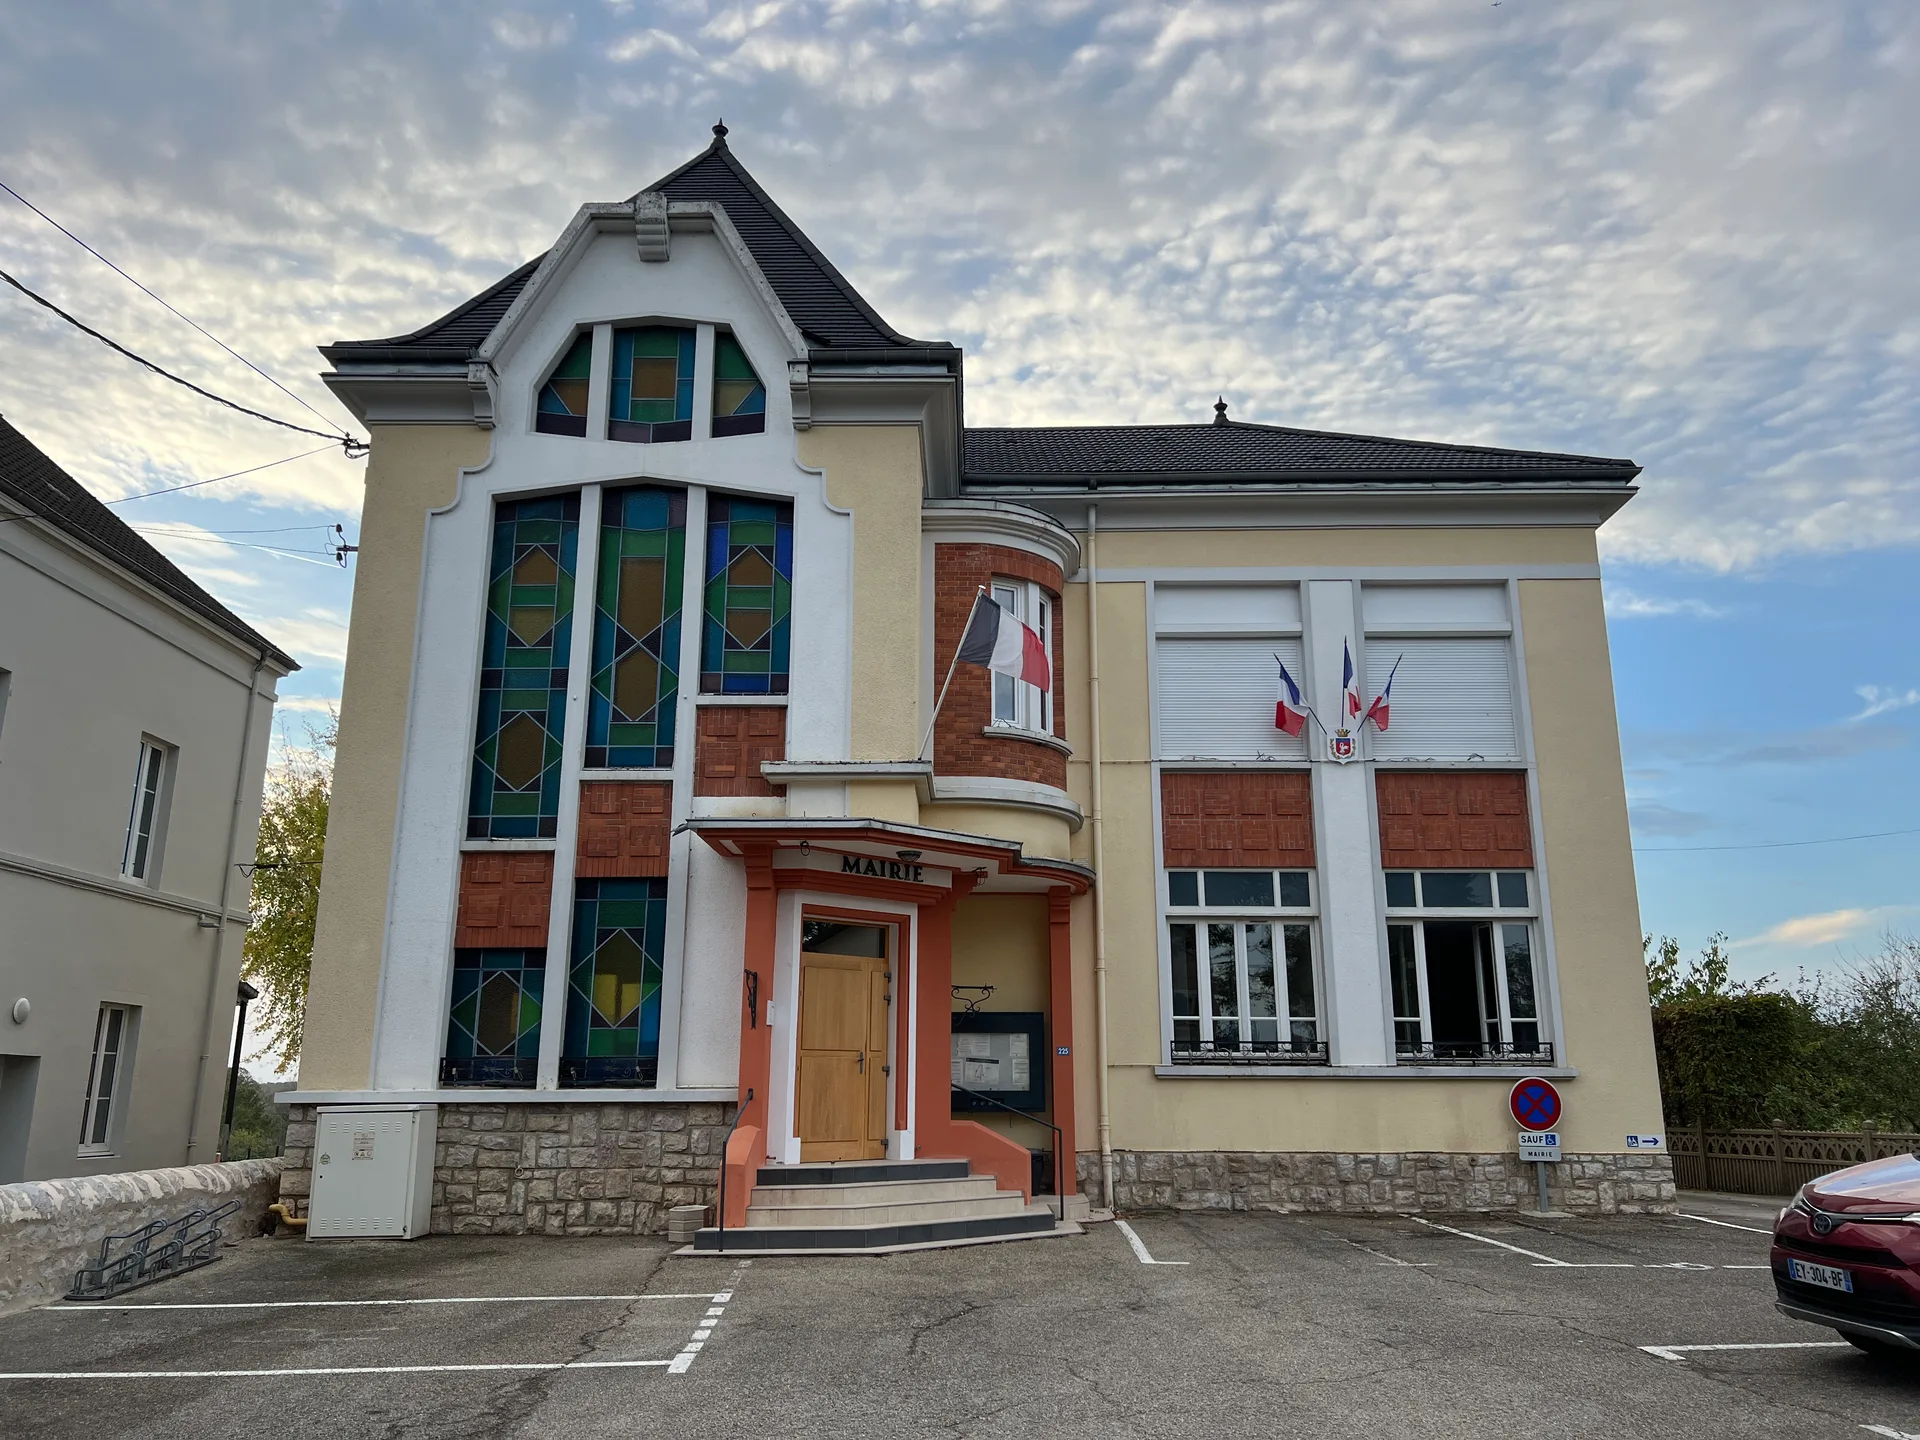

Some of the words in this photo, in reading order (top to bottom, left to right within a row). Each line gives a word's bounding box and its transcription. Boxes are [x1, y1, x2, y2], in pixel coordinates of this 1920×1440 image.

[841, 856, 924, 882] MAIRIE
[1058, 1047, 1069, 1055] 225
[1521, 1135, 1544, 1144] SAUF
[1794, 1262, 1843, 1288] EY-304-BF
